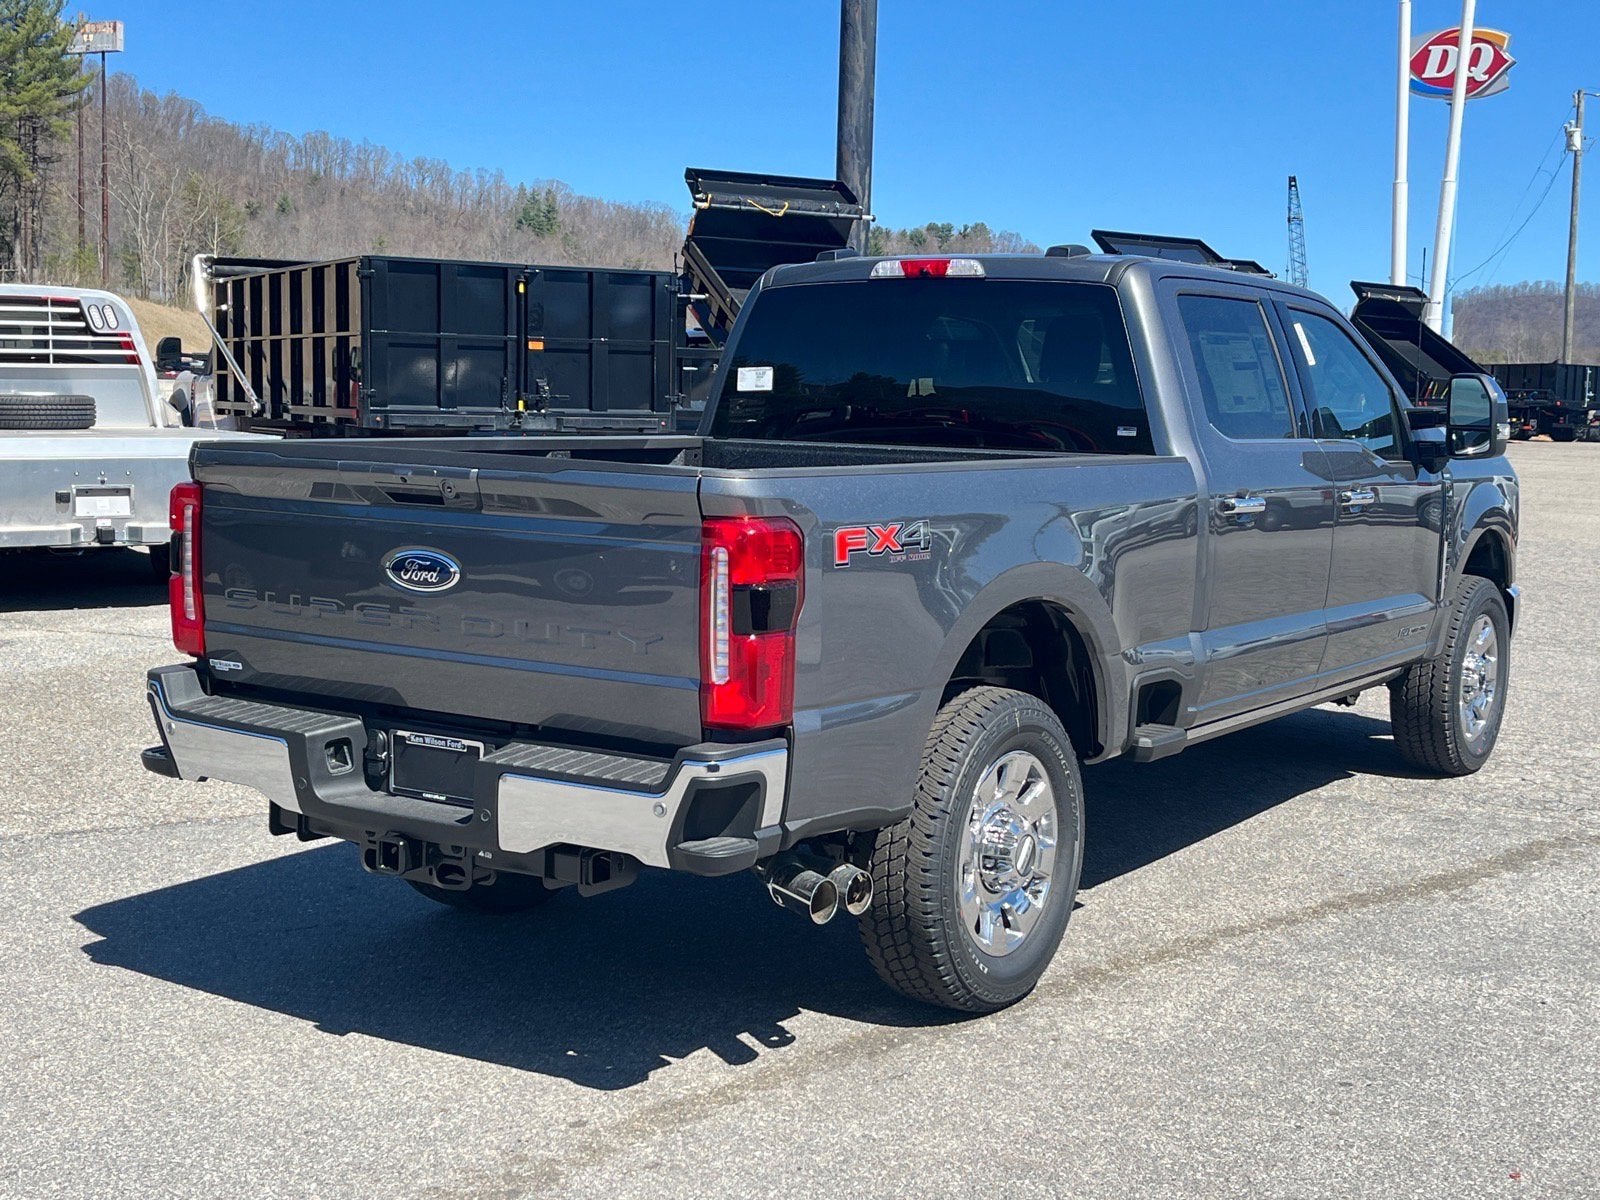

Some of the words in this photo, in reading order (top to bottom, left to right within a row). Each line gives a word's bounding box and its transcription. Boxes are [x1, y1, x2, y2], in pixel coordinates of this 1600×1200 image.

[1421, 43, 1495, 82] DQ
[833, 520, 932, 568] FX4
[400, 558, 440, 583] Ford
[224, 587, 441, 632] SUPER
[460, 614, 664, 655] DUTY
[410, 734, 424, 743] Ken
[424, 736, 446, 747] Wilson
[446, 739, 462, 749] Ford
